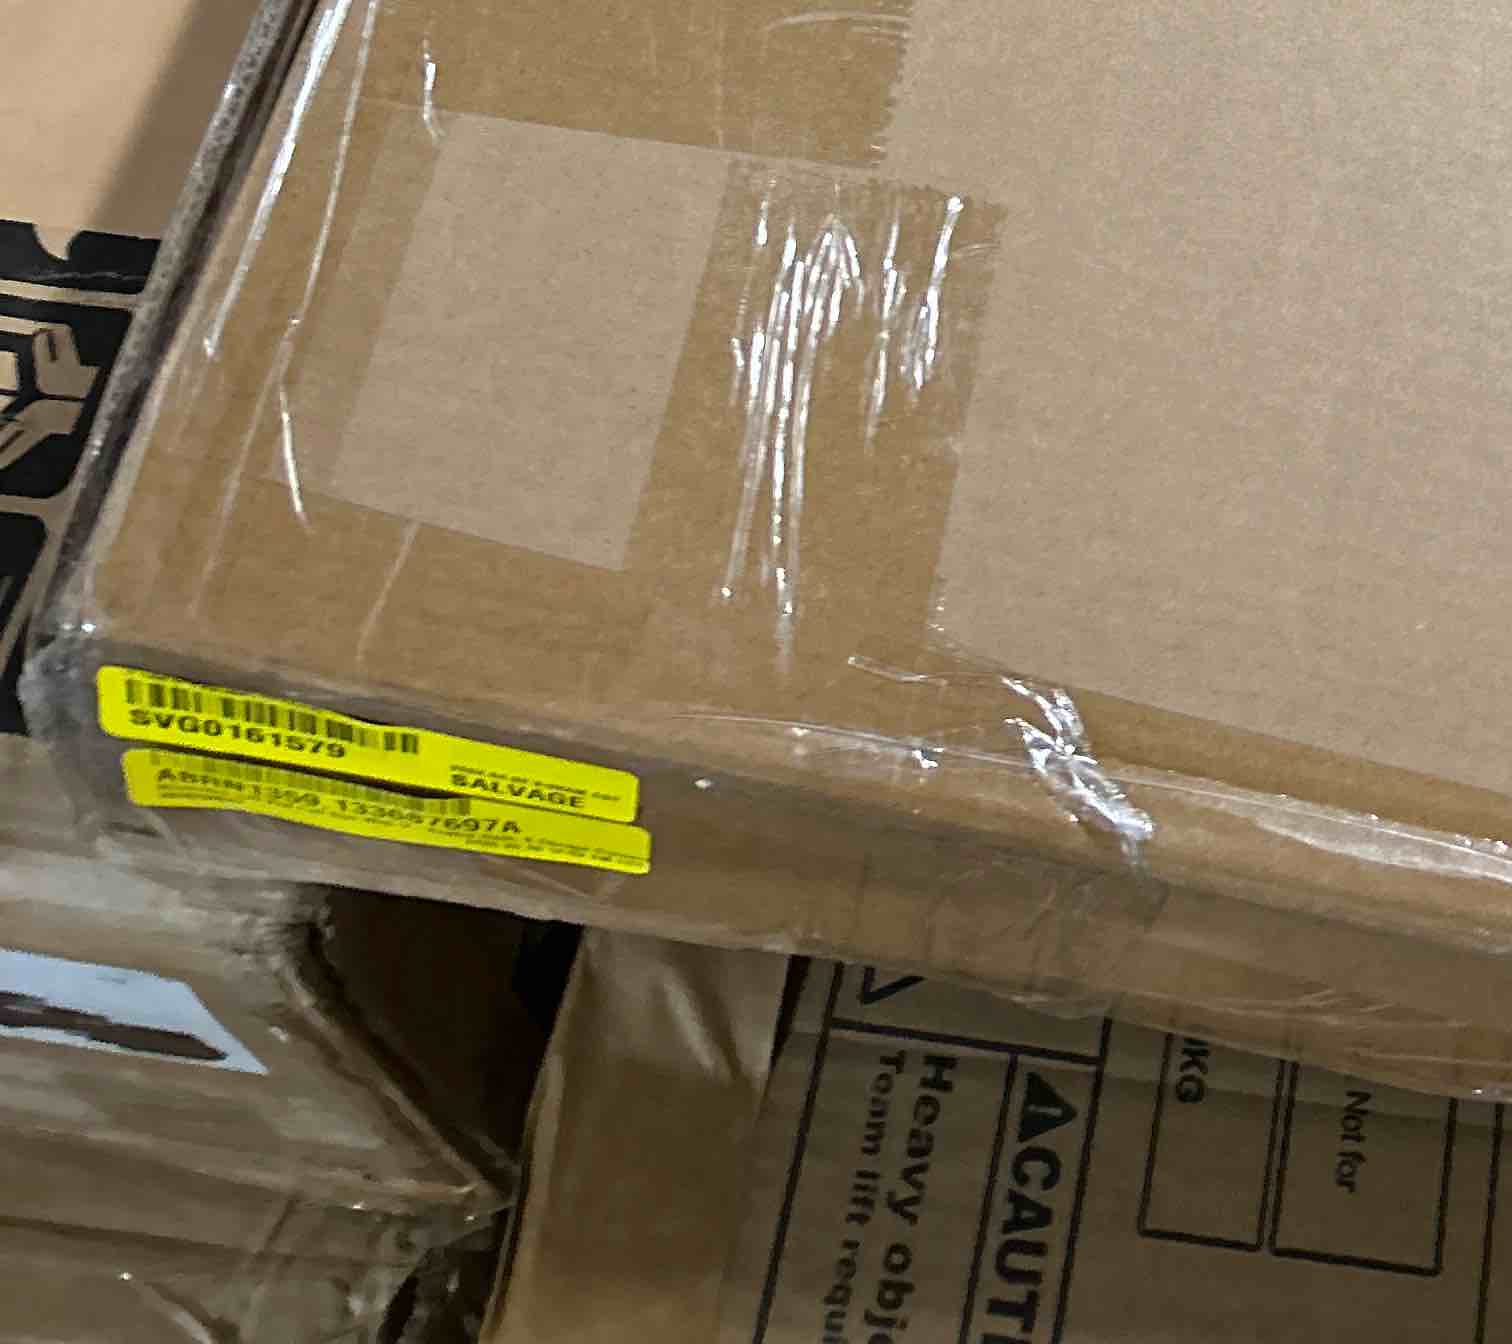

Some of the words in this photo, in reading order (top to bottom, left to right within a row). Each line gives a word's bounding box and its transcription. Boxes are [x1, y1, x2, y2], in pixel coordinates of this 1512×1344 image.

[451, 773, 586, 809] SALVAGE
[860, 1049, 908, 1157] Team
[1334, 1089, 1373, 1144] Not
[885, 1053, 959, 1226] Heavy
[844, 1169, 881, 1226] lift
[1334, 1149, 1363, 1194] for
